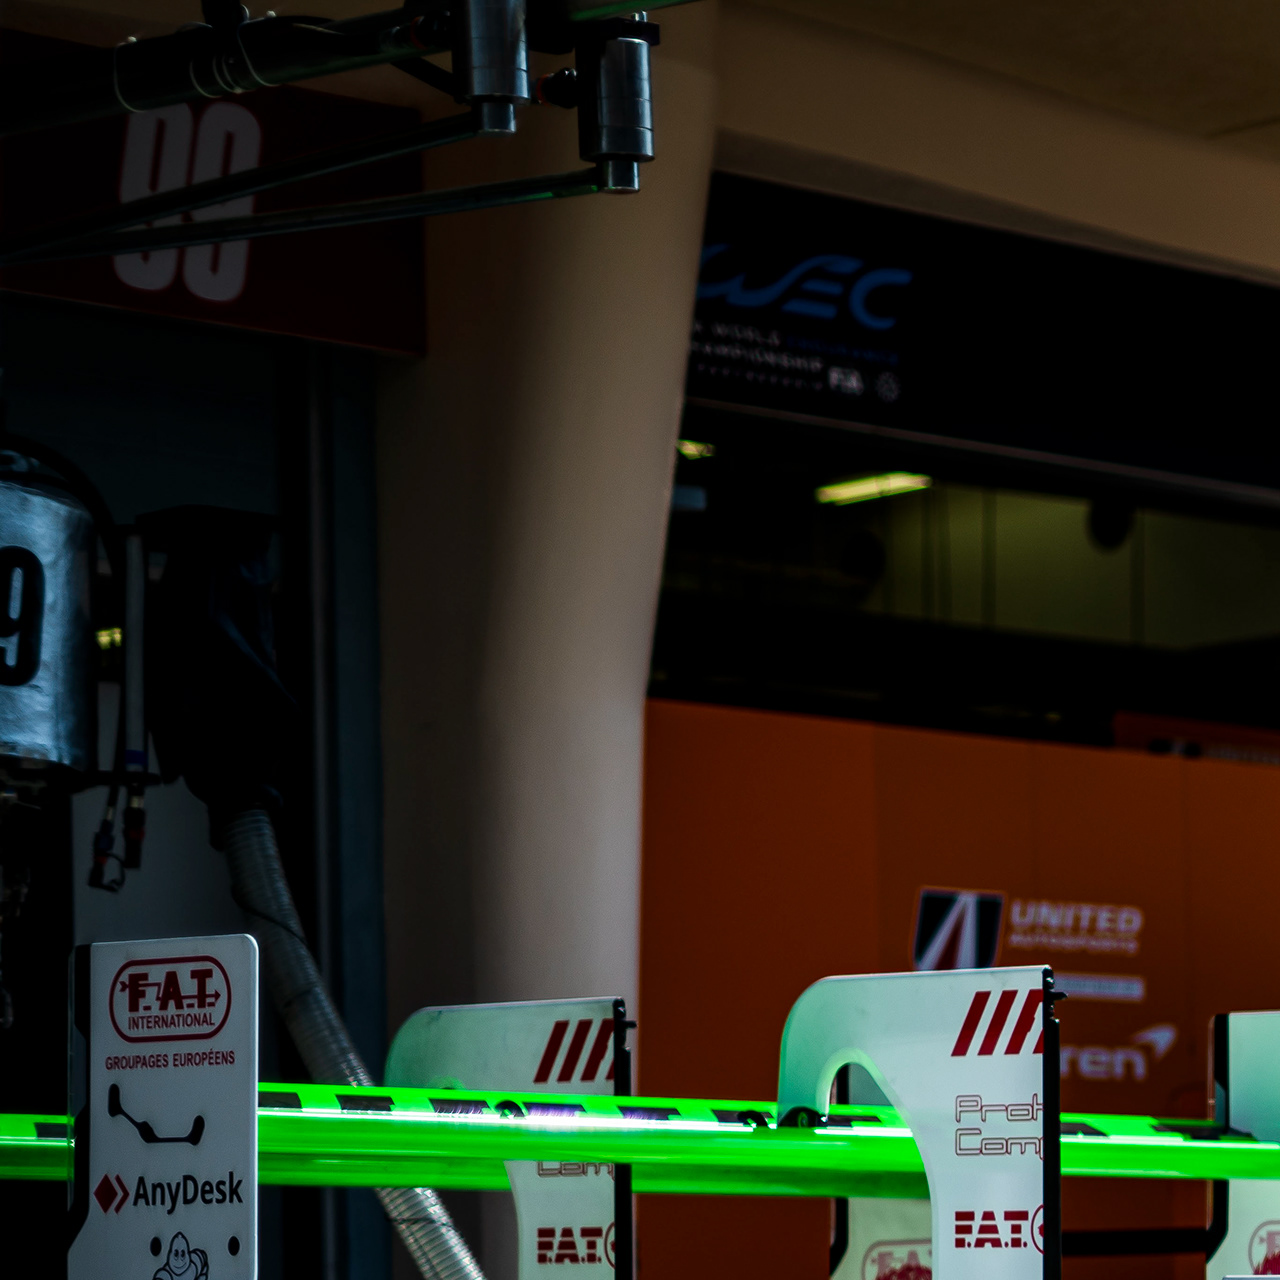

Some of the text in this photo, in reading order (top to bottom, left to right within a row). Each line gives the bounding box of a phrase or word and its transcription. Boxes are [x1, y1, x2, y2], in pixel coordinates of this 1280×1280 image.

[1009, 900, 1145, 934] UNITED
[127, 1012, 216, 1031] INTERNATIONAL
[105, 1048, 236, 1071] GROUPAGES EUROPÉENS
[132, 1171, 245, 1216] AnyDesk
